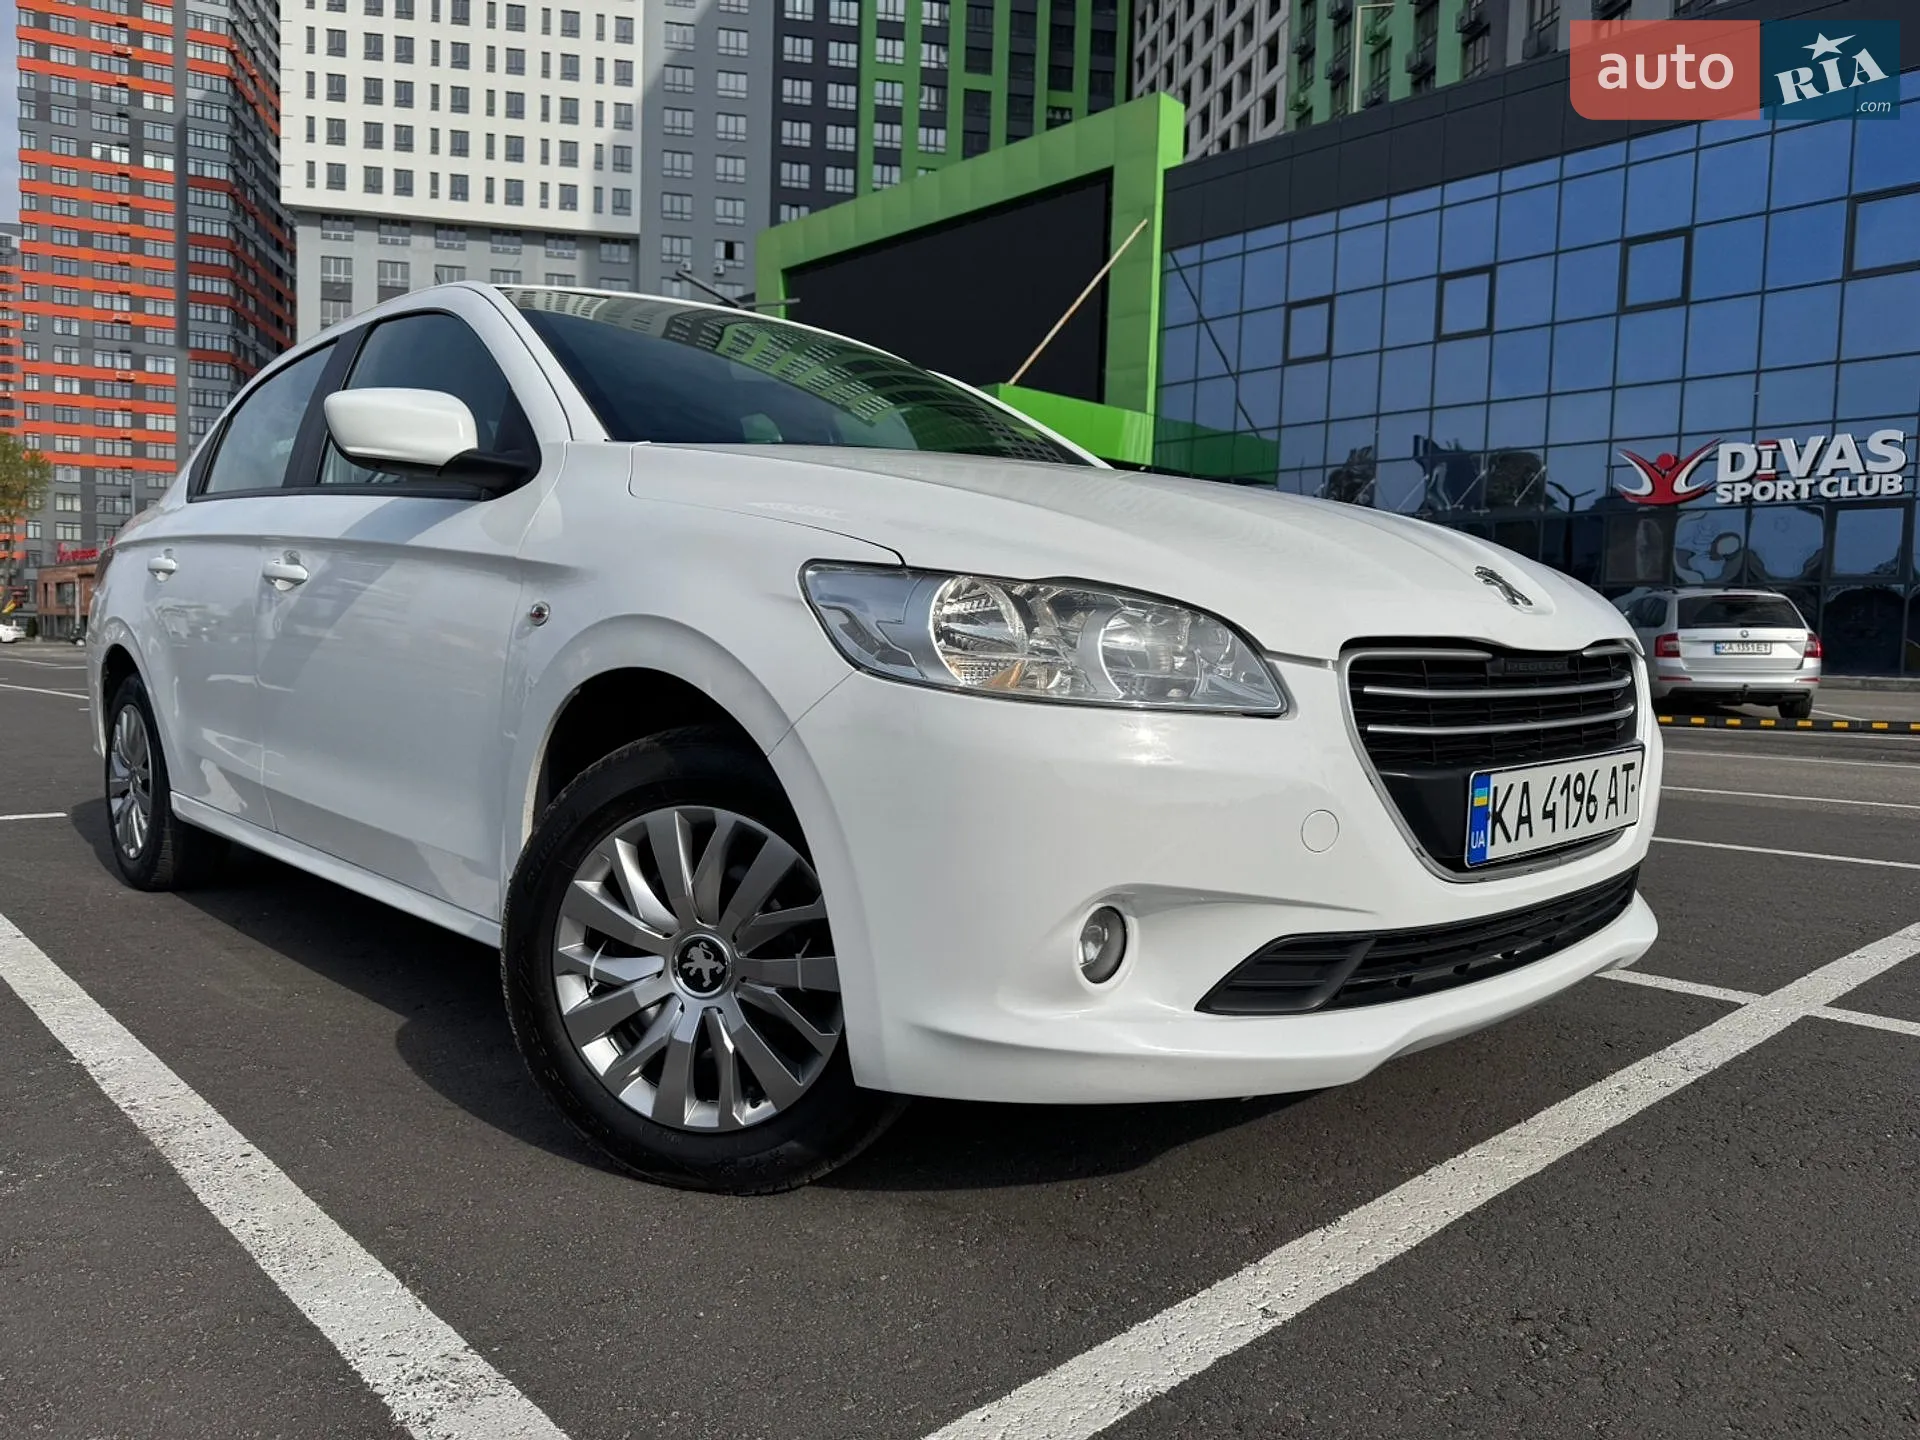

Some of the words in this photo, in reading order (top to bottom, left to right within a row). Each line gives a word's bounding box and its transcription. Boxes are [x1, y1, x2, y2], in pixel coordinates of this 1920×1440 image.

[1716, 478, 1815, 503] SPORT
[1819, 473, 1903, 498] CLUB
[1490, 781, 1533, 846] KA
[1541, 769, 1600, 833] 4196
[1605, 762, 1636, 820] AT
[1470, 830, 1486, 849] UA
